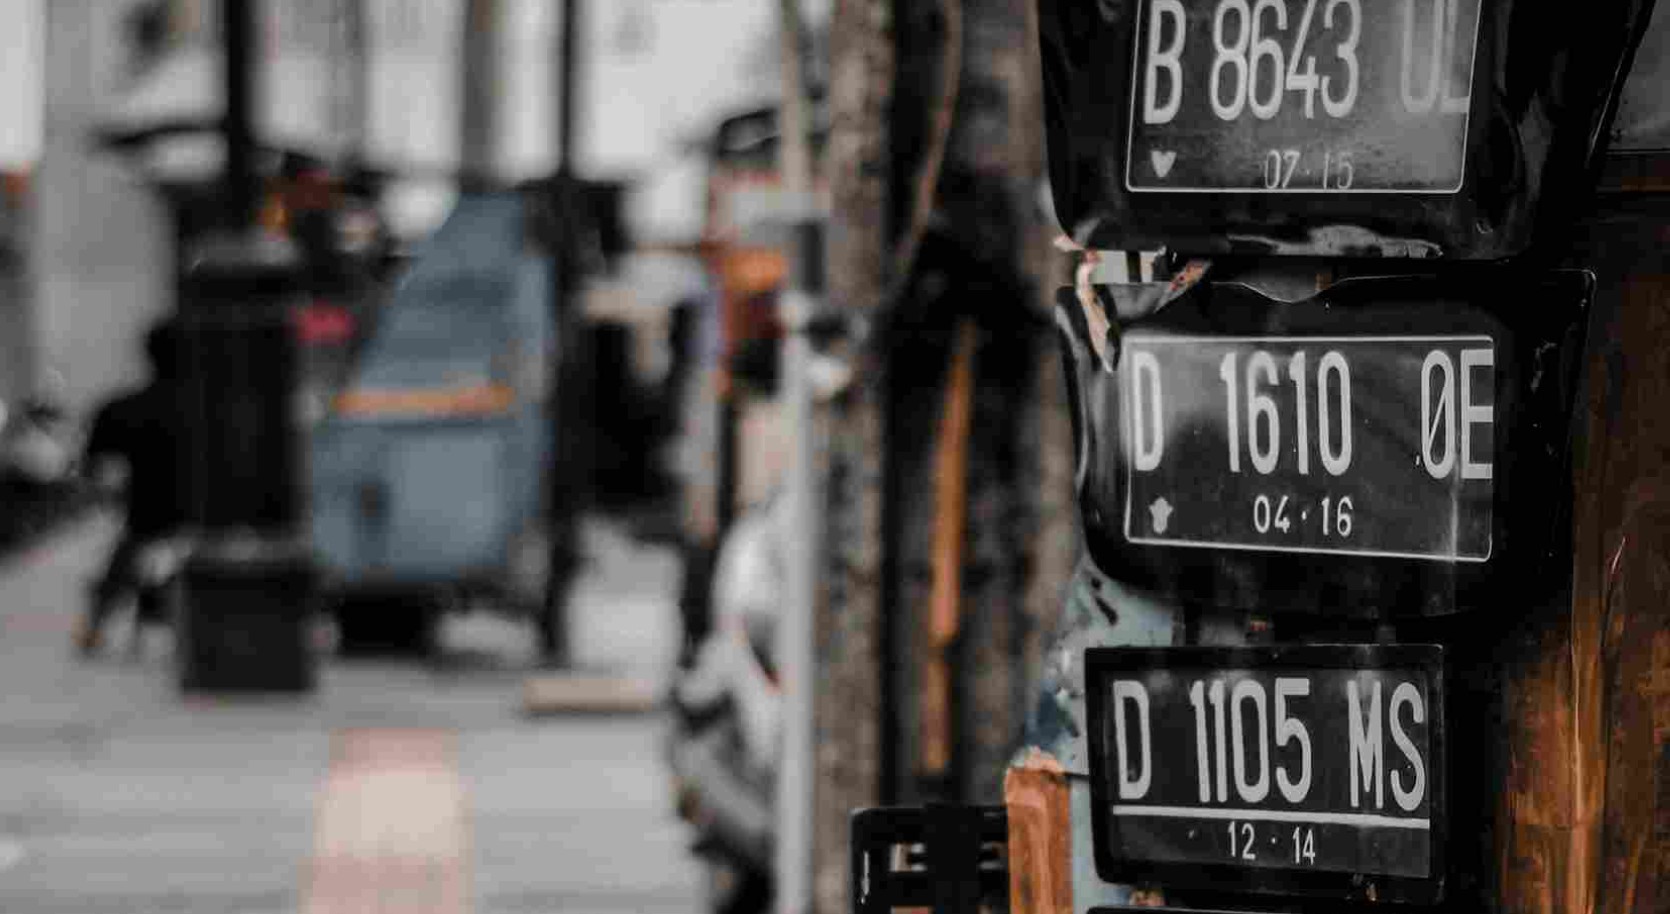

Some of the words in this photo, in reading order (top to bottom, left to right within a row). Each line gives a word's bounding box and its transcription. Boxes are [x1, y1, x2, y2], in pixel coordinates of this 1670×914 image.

[1144, 0, 1186, 124] B
[1209, 0, 1362, 121] 8643
[1133, 351, 1164, 471] D
[1219, 350, 1352, 476] 1610
[1253, 496, 1291, 534] 04
[1321, 496, 1353, 537] 16
[1113, 680, 1152, 800] D
[1190, 677, 1312, 803] 1105
[1347, 680, 1426, 812] MS
[1228, 820, 1256, 860] 12
[1292, 826, 1316, 865] 14
